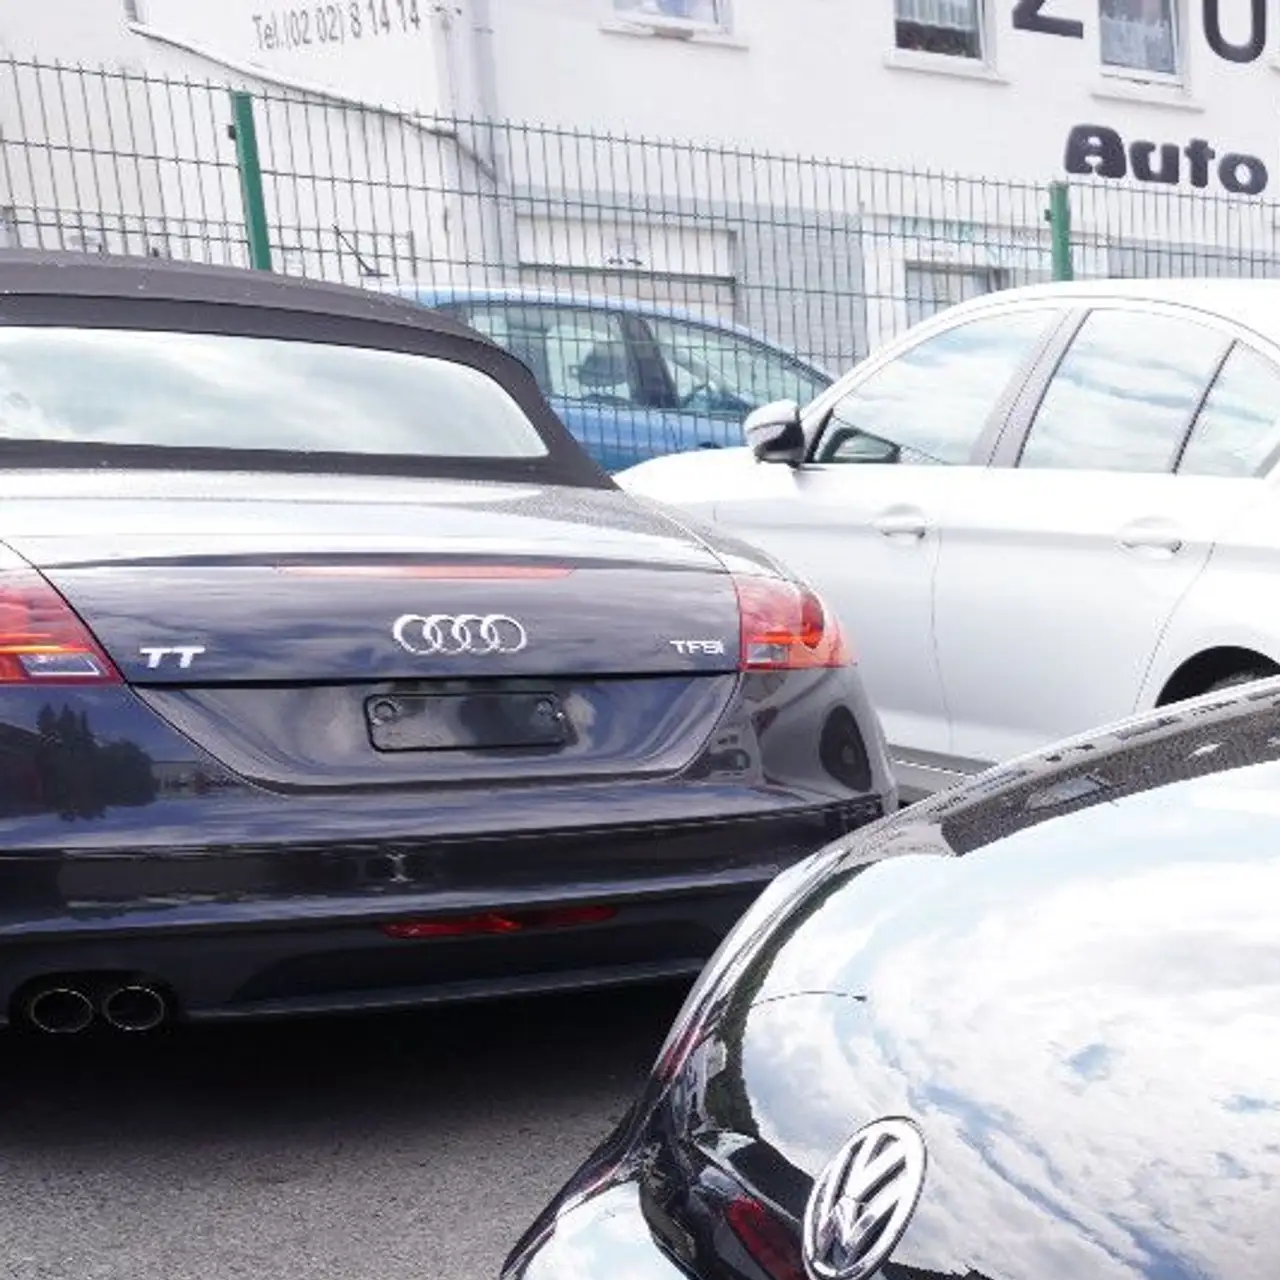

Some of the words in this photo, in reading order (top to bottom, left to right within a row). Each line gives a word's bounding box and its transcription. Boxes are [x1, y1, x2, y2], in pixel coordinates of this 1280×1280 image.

[350, 1, 362, 38] 8
[368, 0, 391, 35] 14
[397, 0, 421, 31] 14
[1064, 123, 1269, 195] Auto
[140, 646, 206, 669] TT
